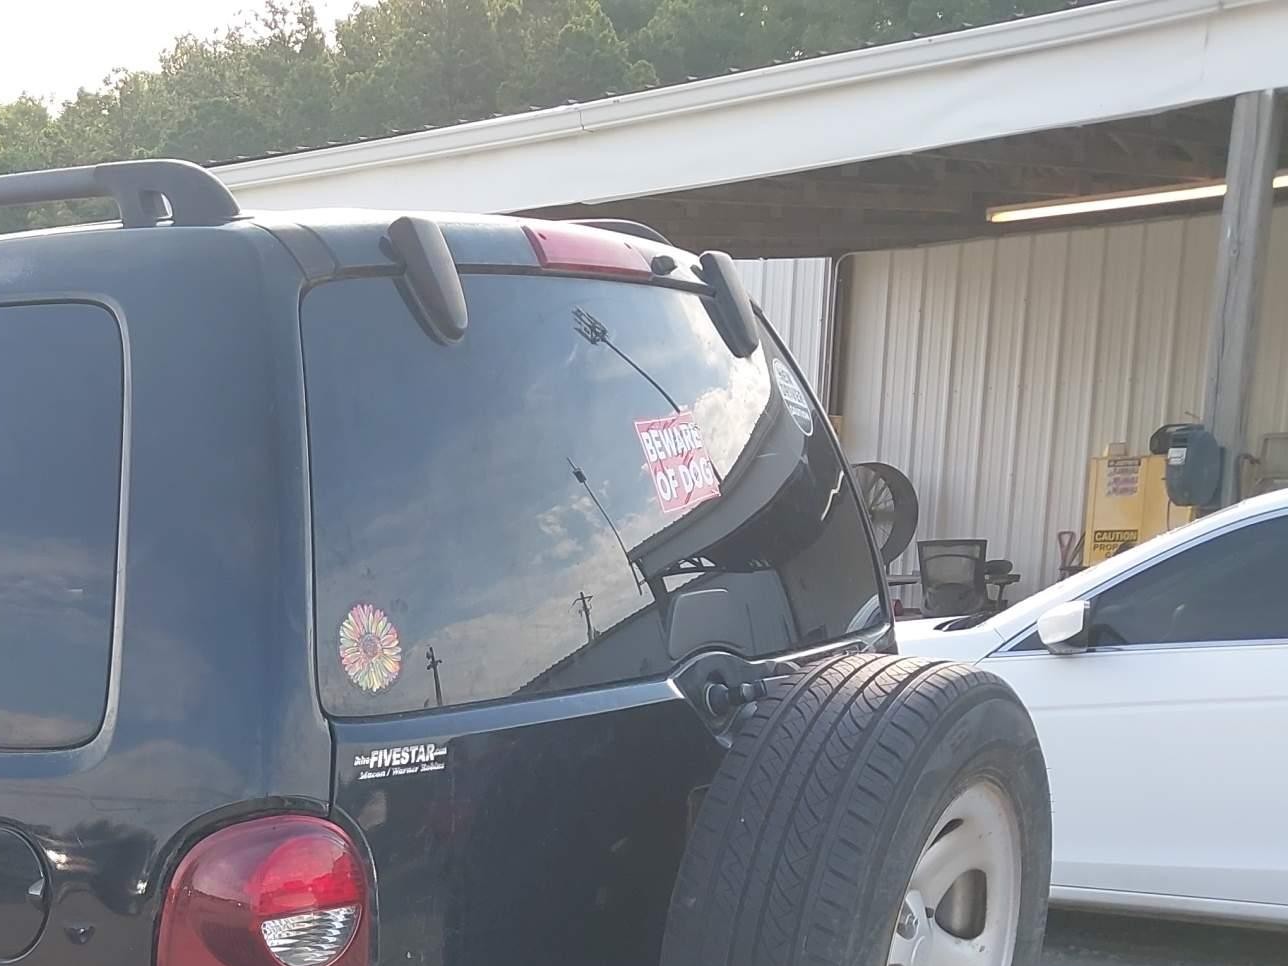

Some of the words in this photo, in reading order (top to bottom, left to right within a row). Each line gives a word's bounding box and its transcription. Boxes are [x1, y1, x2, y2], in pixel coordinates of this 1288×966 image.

[640, 422, 703, 462] BEWARE
[656, 468, 678, 501] OF
[678, 457, 713, 494] DOG
[1095, 531, 1137, 542] CAUTION
